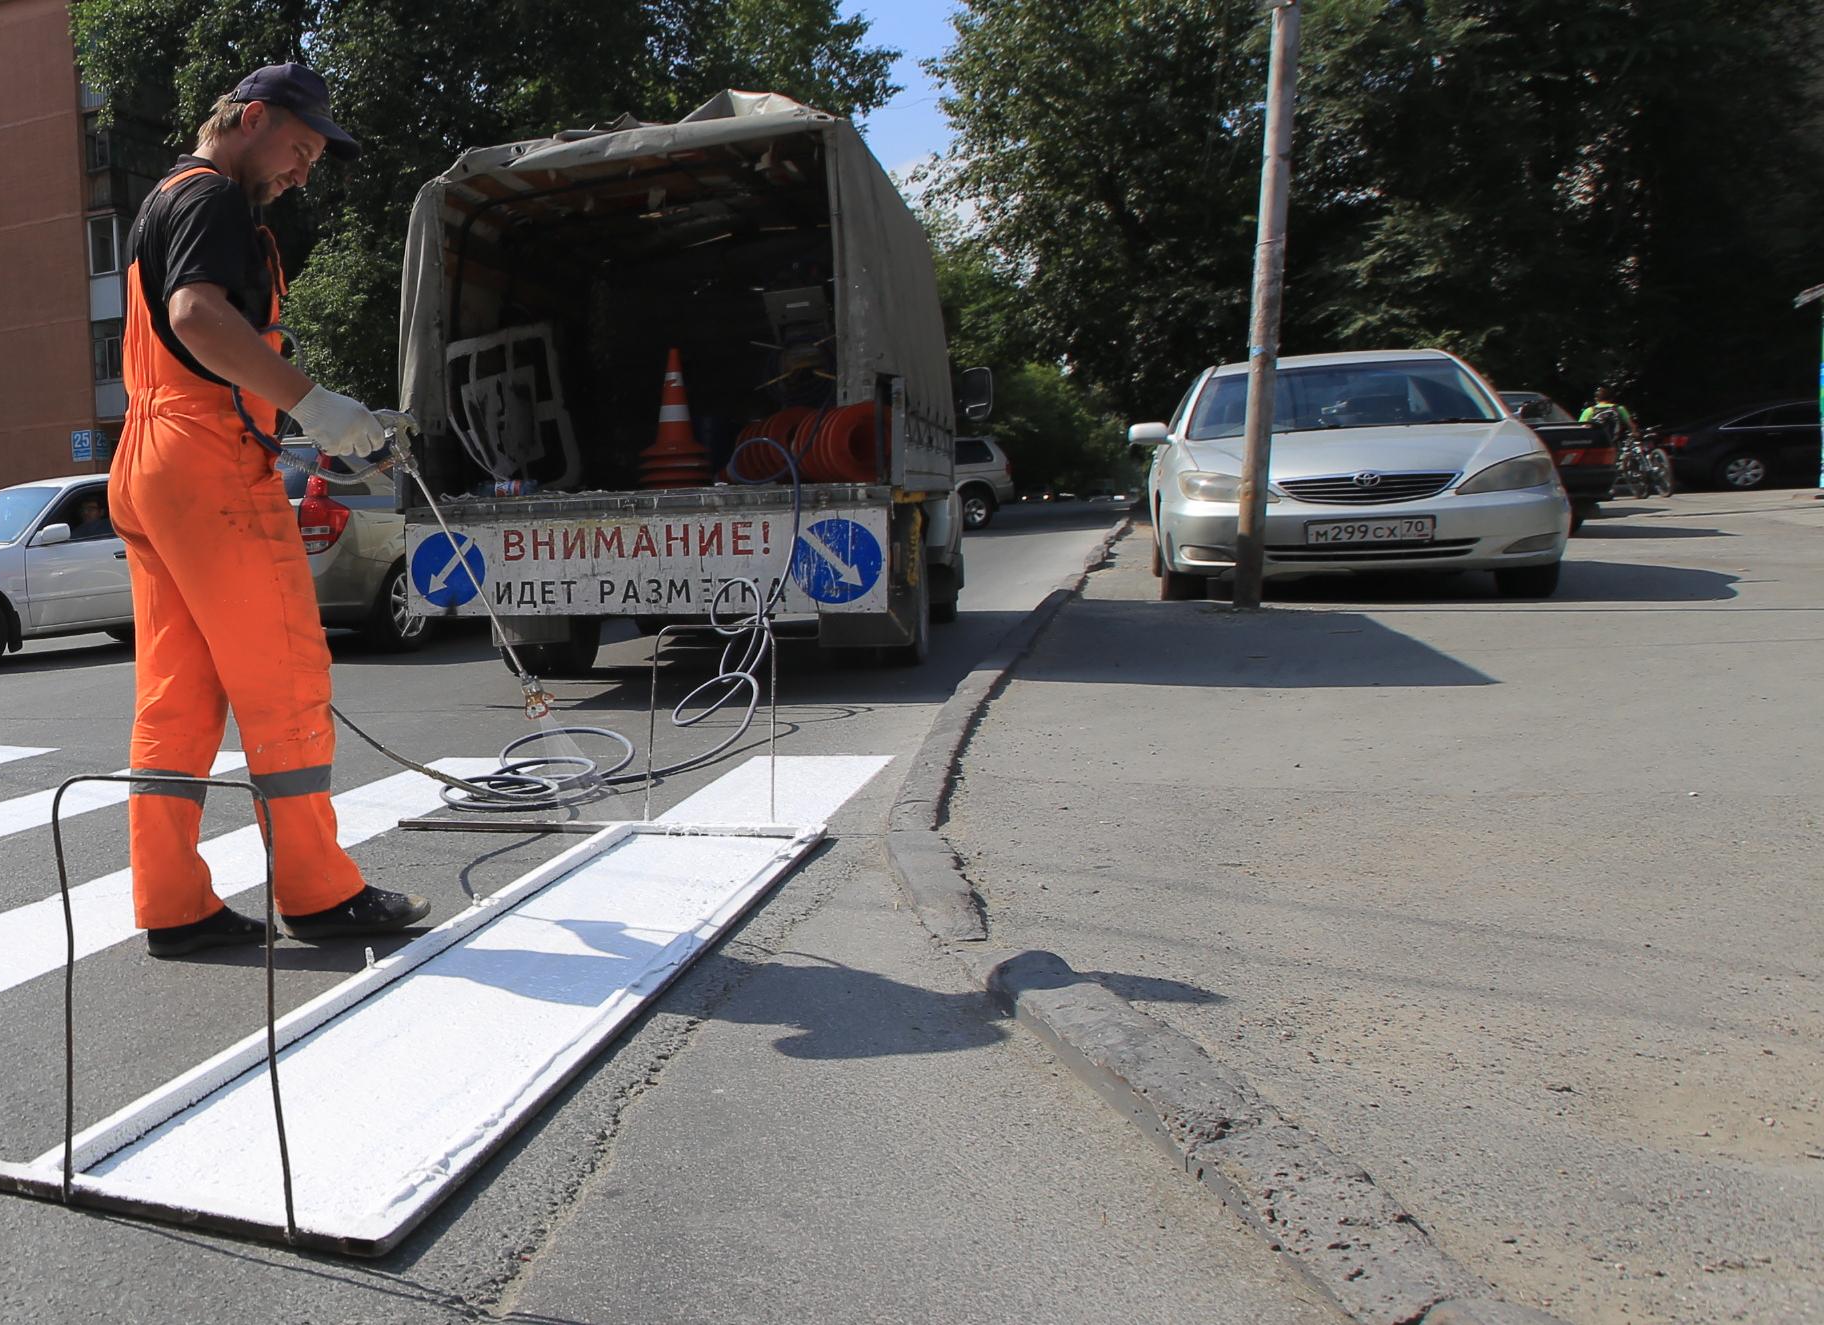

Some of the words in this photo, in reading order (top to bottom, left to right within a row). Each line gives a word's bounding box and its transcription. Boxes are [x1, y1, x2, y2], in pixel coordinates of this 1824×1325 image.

[74, 432, 90, 448] 25
[1404, 520, 1425, 533] 70
[503, 521, 770, 562] ВНИМАНИЕ!
[495, 580, 578, 608] ИДЕТ
[599, 577, 787, 605] РАЗМЕТКА
